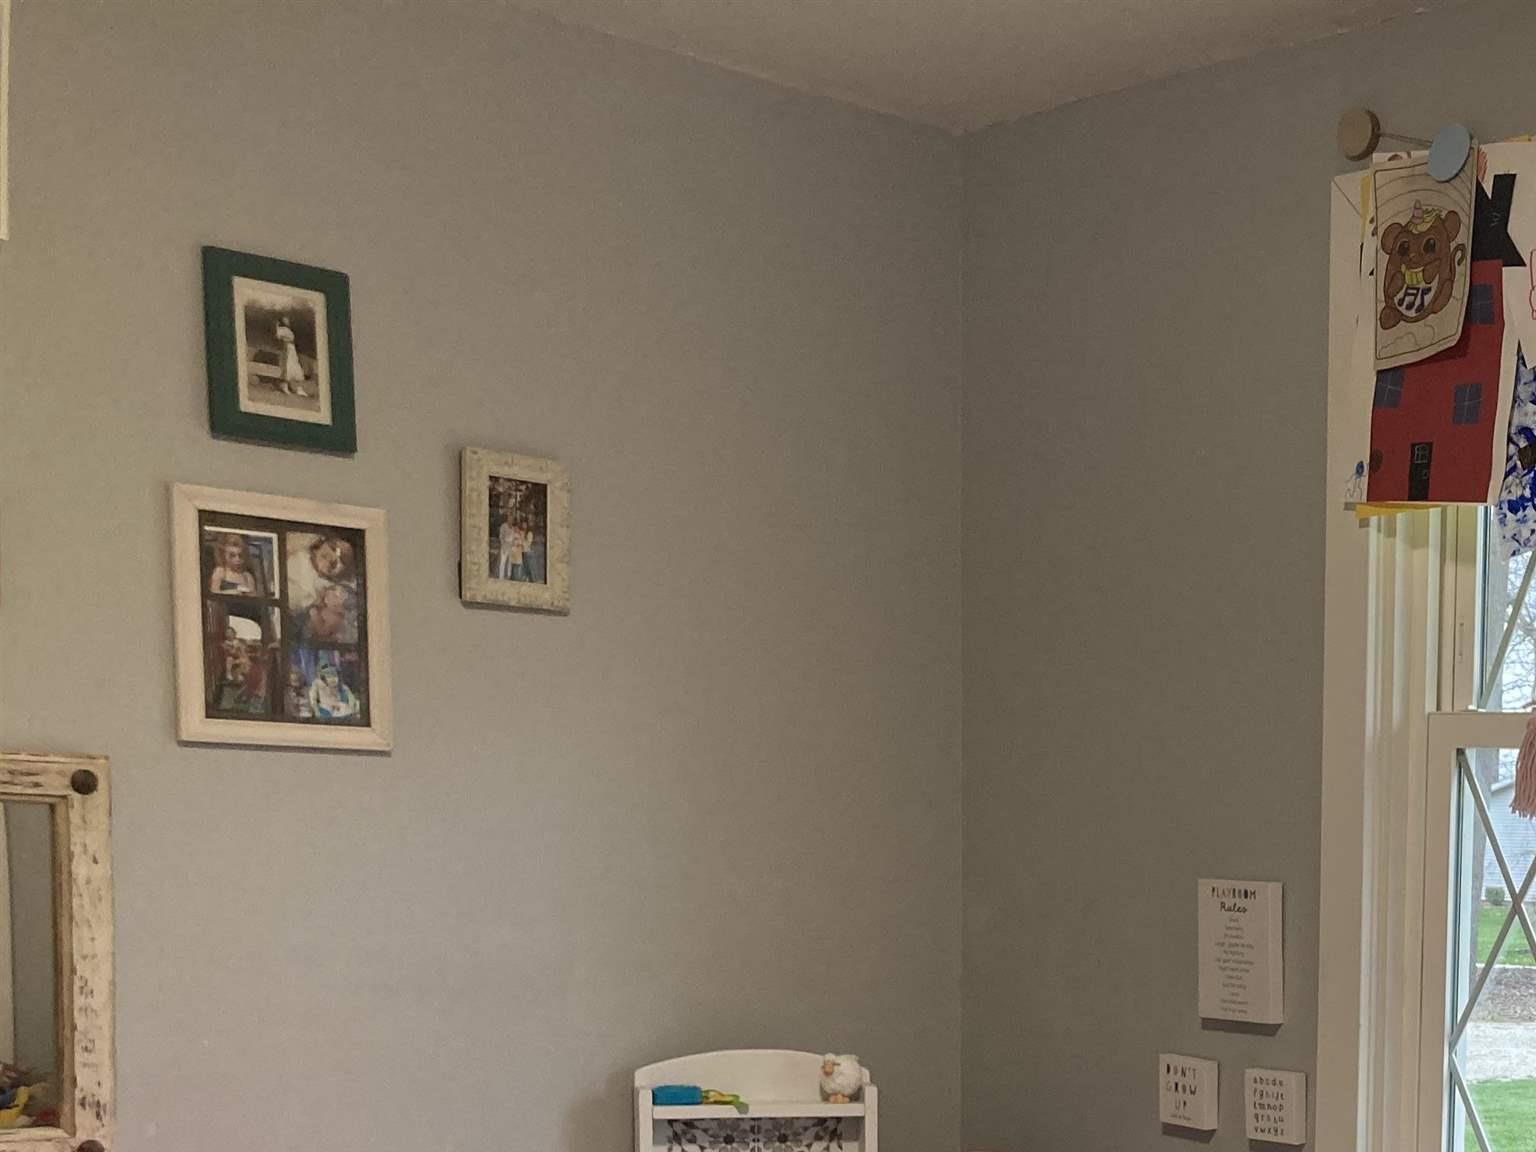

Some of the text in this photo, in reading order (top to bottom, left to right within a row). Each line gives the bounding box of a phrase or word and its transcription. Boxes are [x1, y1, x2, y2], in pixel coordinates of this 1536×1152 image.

[1211, 886, 1257, 900] PLAYROOM
[1219, 901, 1248, 914] Rules
[1166, 1081, 1198, 1097] GROW
[1175, 1098, 1188, 1113] UP
